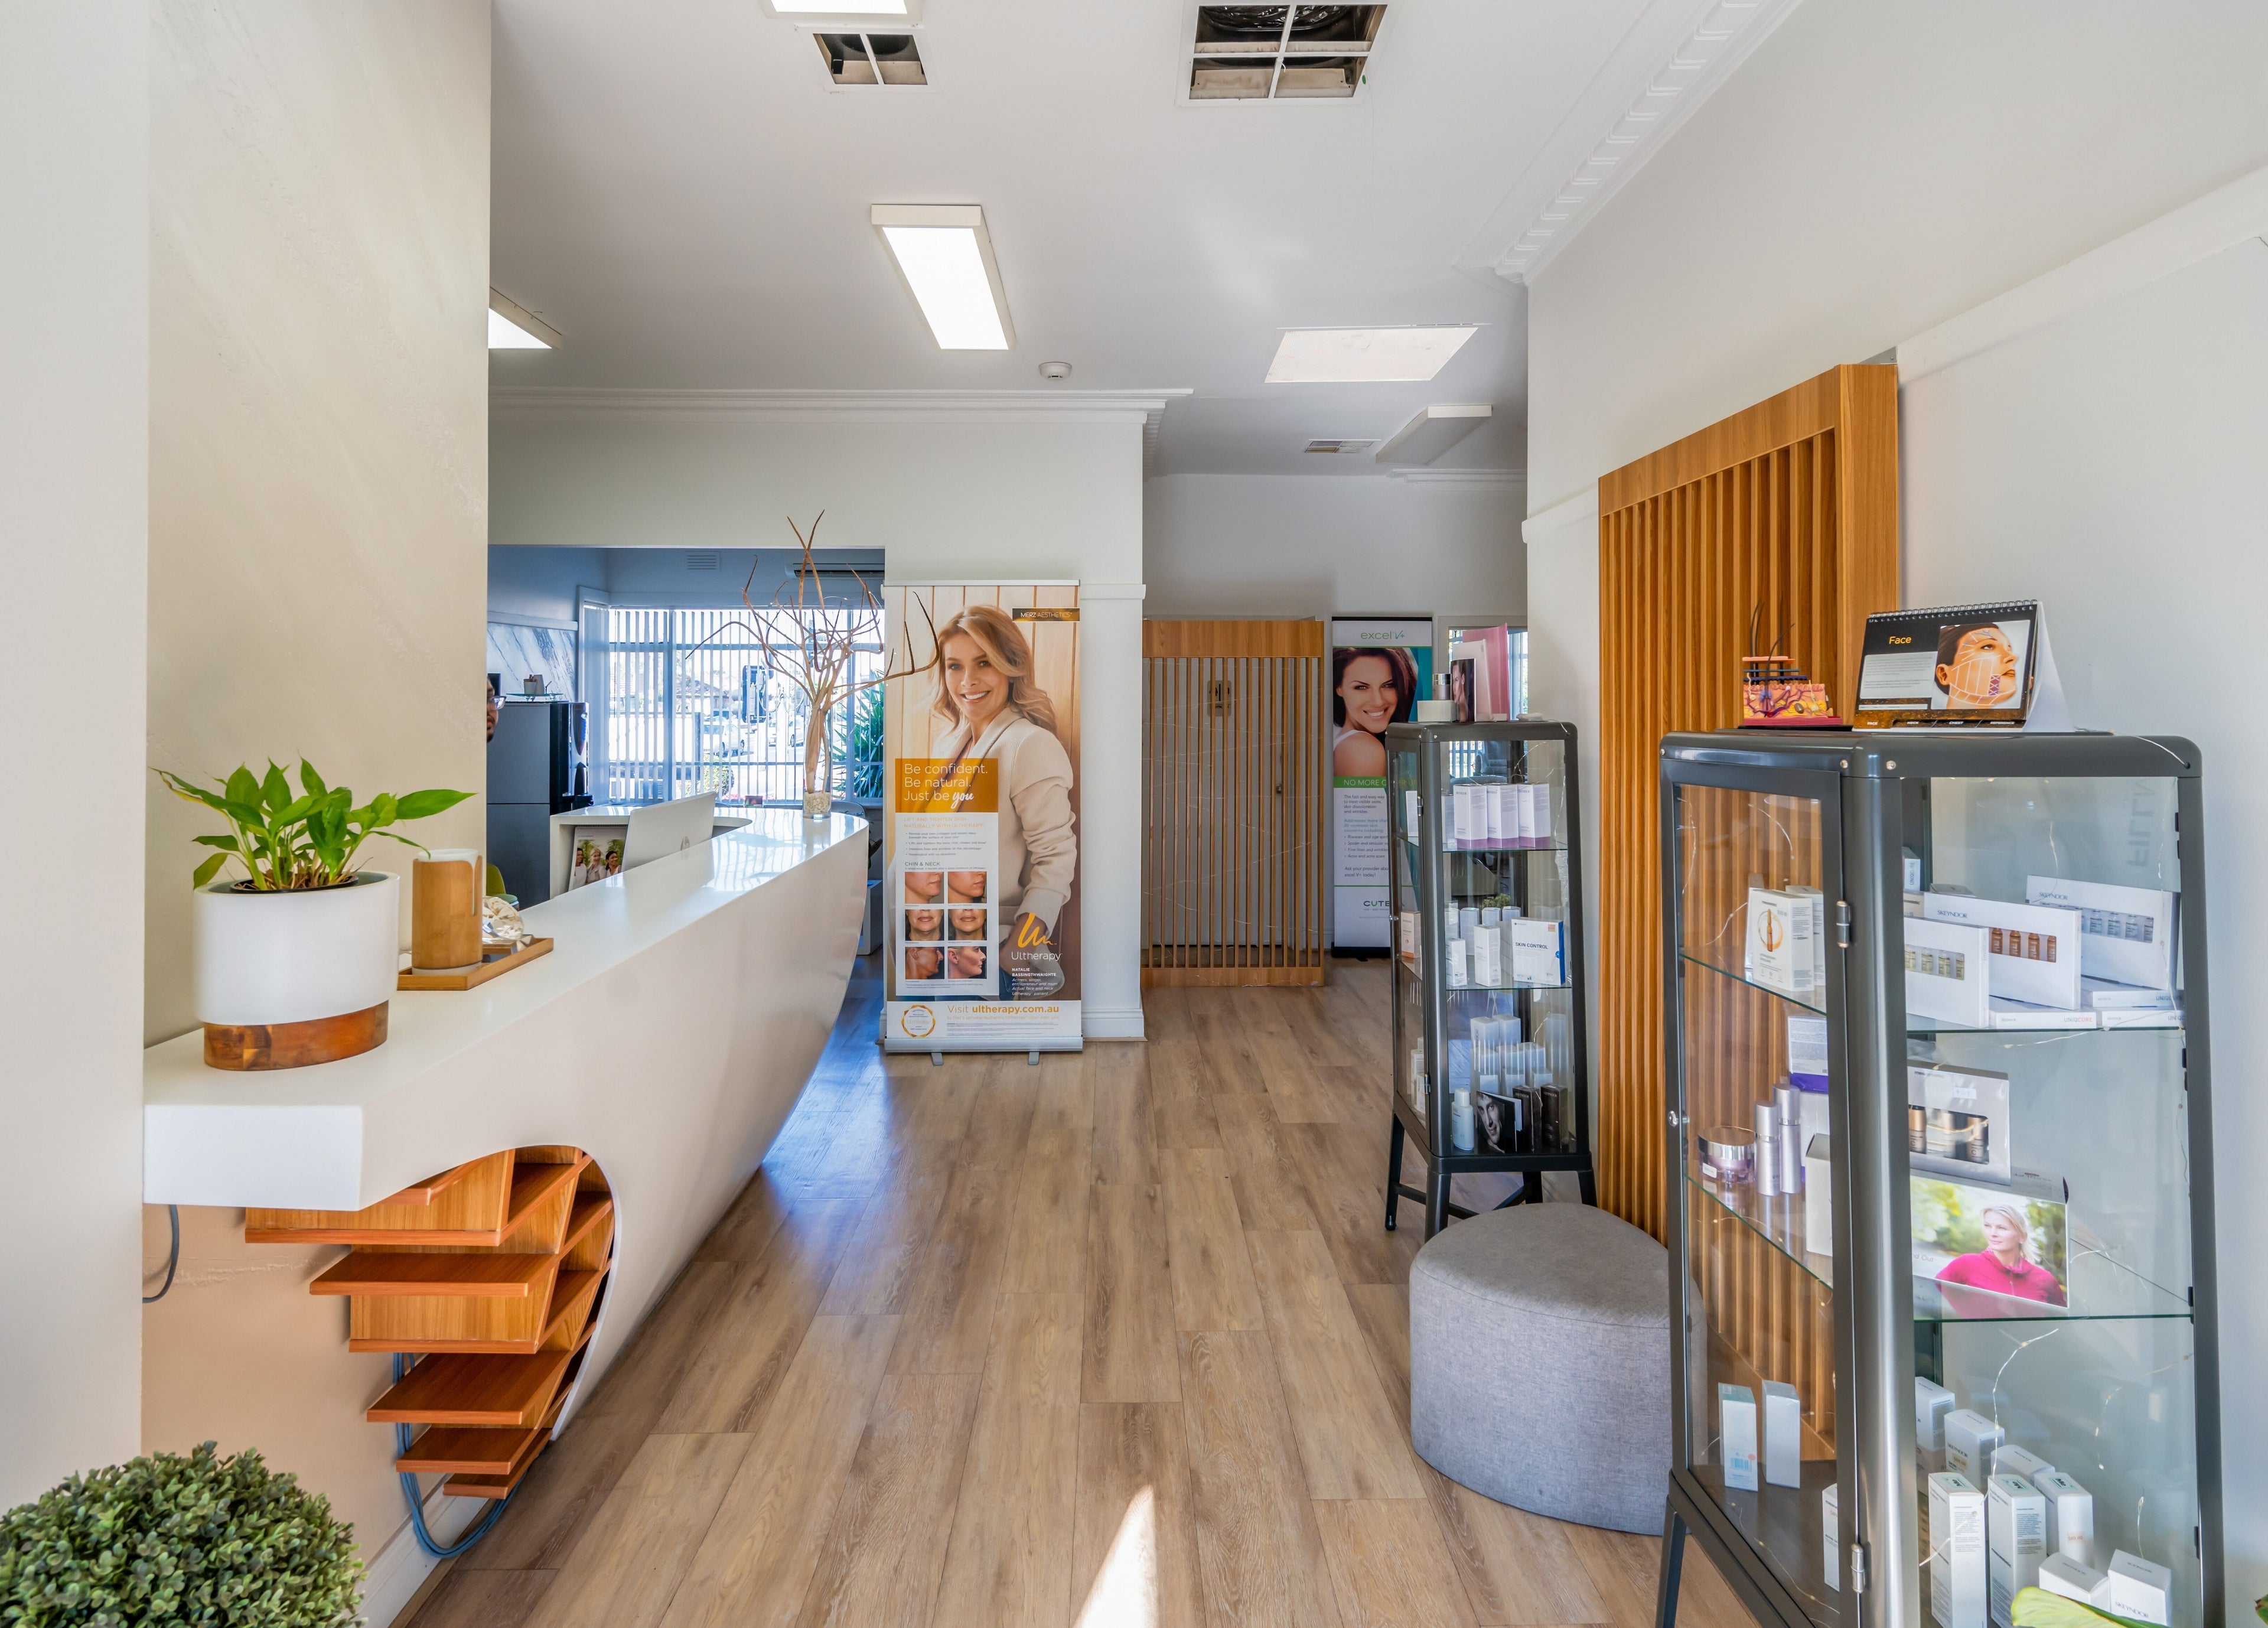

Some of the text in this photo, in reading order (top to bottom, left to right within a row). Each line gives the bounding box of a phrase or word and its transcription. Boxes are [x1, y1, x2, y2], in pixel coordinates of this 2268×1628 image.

[1361, 630, 1392, 640] excel
[1889, 636, 1912, 644] Face
[905, 763, 988, 774] Be confident.
[905, 777, 971, 787] Be natural.
[904, 790, 974, 809] Just be you
[2039, 892, 2068, 901] SKEYNDOR
[1937, 910, 1967, 919] SKEYNDOR
[1011, 952, 1061, 962] Ultherapy
[947, 1005, 1059, 1014] Visit ultherapy.com.au
[2115, 1601, 2150, 1619] SKEYNDOR
